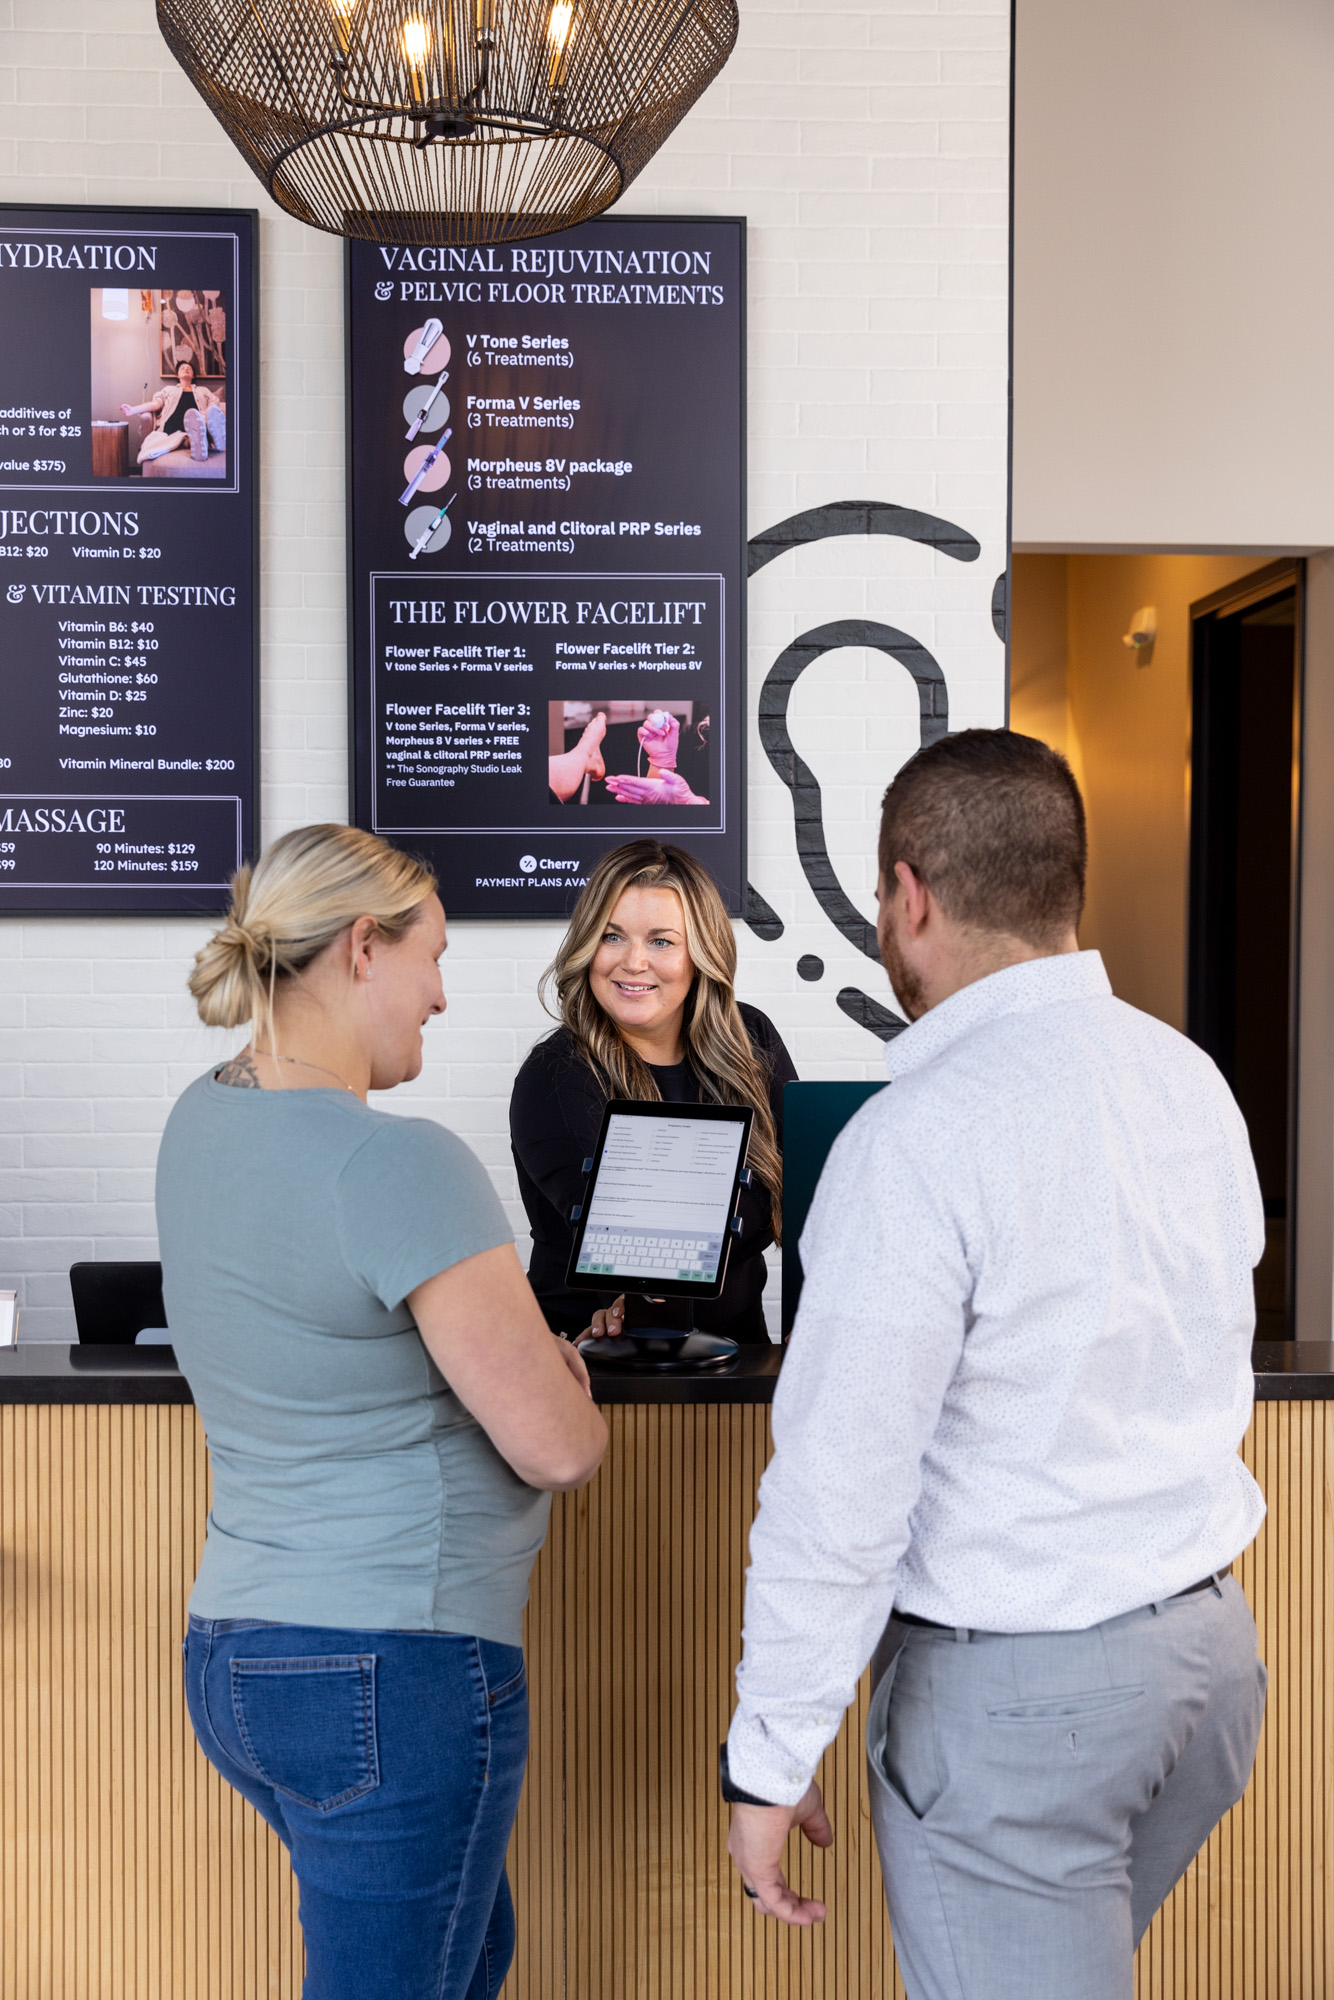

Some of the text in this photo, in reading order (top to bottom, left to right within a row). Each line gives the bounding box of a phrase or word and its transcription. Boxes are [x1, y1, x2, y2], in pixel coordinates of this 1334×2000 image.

[0, 243, 157, 270] YDRATION
[379, 247, 711, 278] VAGINAL REJUVINATION
[374, 281, 724, 305] & PELVIC FLOOR TREATMENTS
[466, 334, 569, 349] V Tone Series
[467, 351, 574, 368] (6 Treatments)
[467, 396, 581, 410] Forma V Series
[0, 407, 71, 419] additives of
[467, 413, 574, 429] (3 Treatments)
[12, 427, 26, 436] or
[28, 425, 36, 436] 3
[38, 425, 57, 436] for
[60, 425, 81, 437] $25
[33, 459, 66, 473] $375)
[468, 458, 633, 475] Morpheus 8V package
[468, 475, 571, 491] (3 treatments)
[0, 510, 139, 539] JECTIONS
[467, 521, 701, 538] Vaginal and Clitoral PRP Series
[26, 545, 48, 558] $20
[468, 537, 575, 554] (2 Treatments)
[72, 546, 161, 559] Vitamin D: $20
[6, 584, 236, 606] & VITAMIN TESTING
[390, 601, 706, 624] THE FLOWER FACELIFT
[58, 620, 154, 633] Vitamin B6: $40
[58, 638, 106, 649] Vitamin
[137, 638, 159, 651] $10
[556, 642, 695, 655] Flower Facelift Tier 2:
[386, 645, 526, 658] Flower Facelift Tier 1:
[58, 655, 147, 668] Vitamin C: $45
[385, 662, 393, 671] V
[394, 662, 417, 671] tone
[419, 662, 450, 671] Series
[461, 662, 493, 671] Forma
[494, 662, 502, 671] V
[503, 662, 533, 671] series
[556, 661, 587, 670] Forma
[589, 661, 596, 670] V
[598, 660, 628, 670] series
[638, 660, 687, 672] Morpheus
[688, 661, 702, 670] 8V
[58, 672, 158, 685] Glutathione: $60
[58, 689, 147, 702] Vitamin D: $25
[59, 706, 113, 719] Zinc: $20
[386, 703, 530, 715] Flower Facelift Tier 3:
[59, 724, 157, 737] Magnesium: $10
[386, 721, 529, 732] V tone Series, Forma V series,
[386, 736, 434, 747] Morpheus
[436, 736, 443, 745] 8
[444, 736, 452, 745] V
[454, 736, 483, 745] series
[494, 736, 519, 745] FREE
[386, 750, 522, 761] vaginal & clitoral PRP series
[59, 758, 235, 771] Vitamin Mineral Bundle: $200
[397, 764, 414, 773] The
[416, 764, 469, 775] Sonography
[470, 764, 499, 773] Studio
[501, 764, 522, 773] Leak
[386, 778, 455, 787] Free Guarantee
[96, 843, 195, 855] 90 Minutes: $129
[94, 860, 199, 872] 120 Minutes: $159
[539, 859, 580, 872] Cherry
[476, 878, 525, 887] PAYMENT
[528, 878, 562, 887] PLANS
